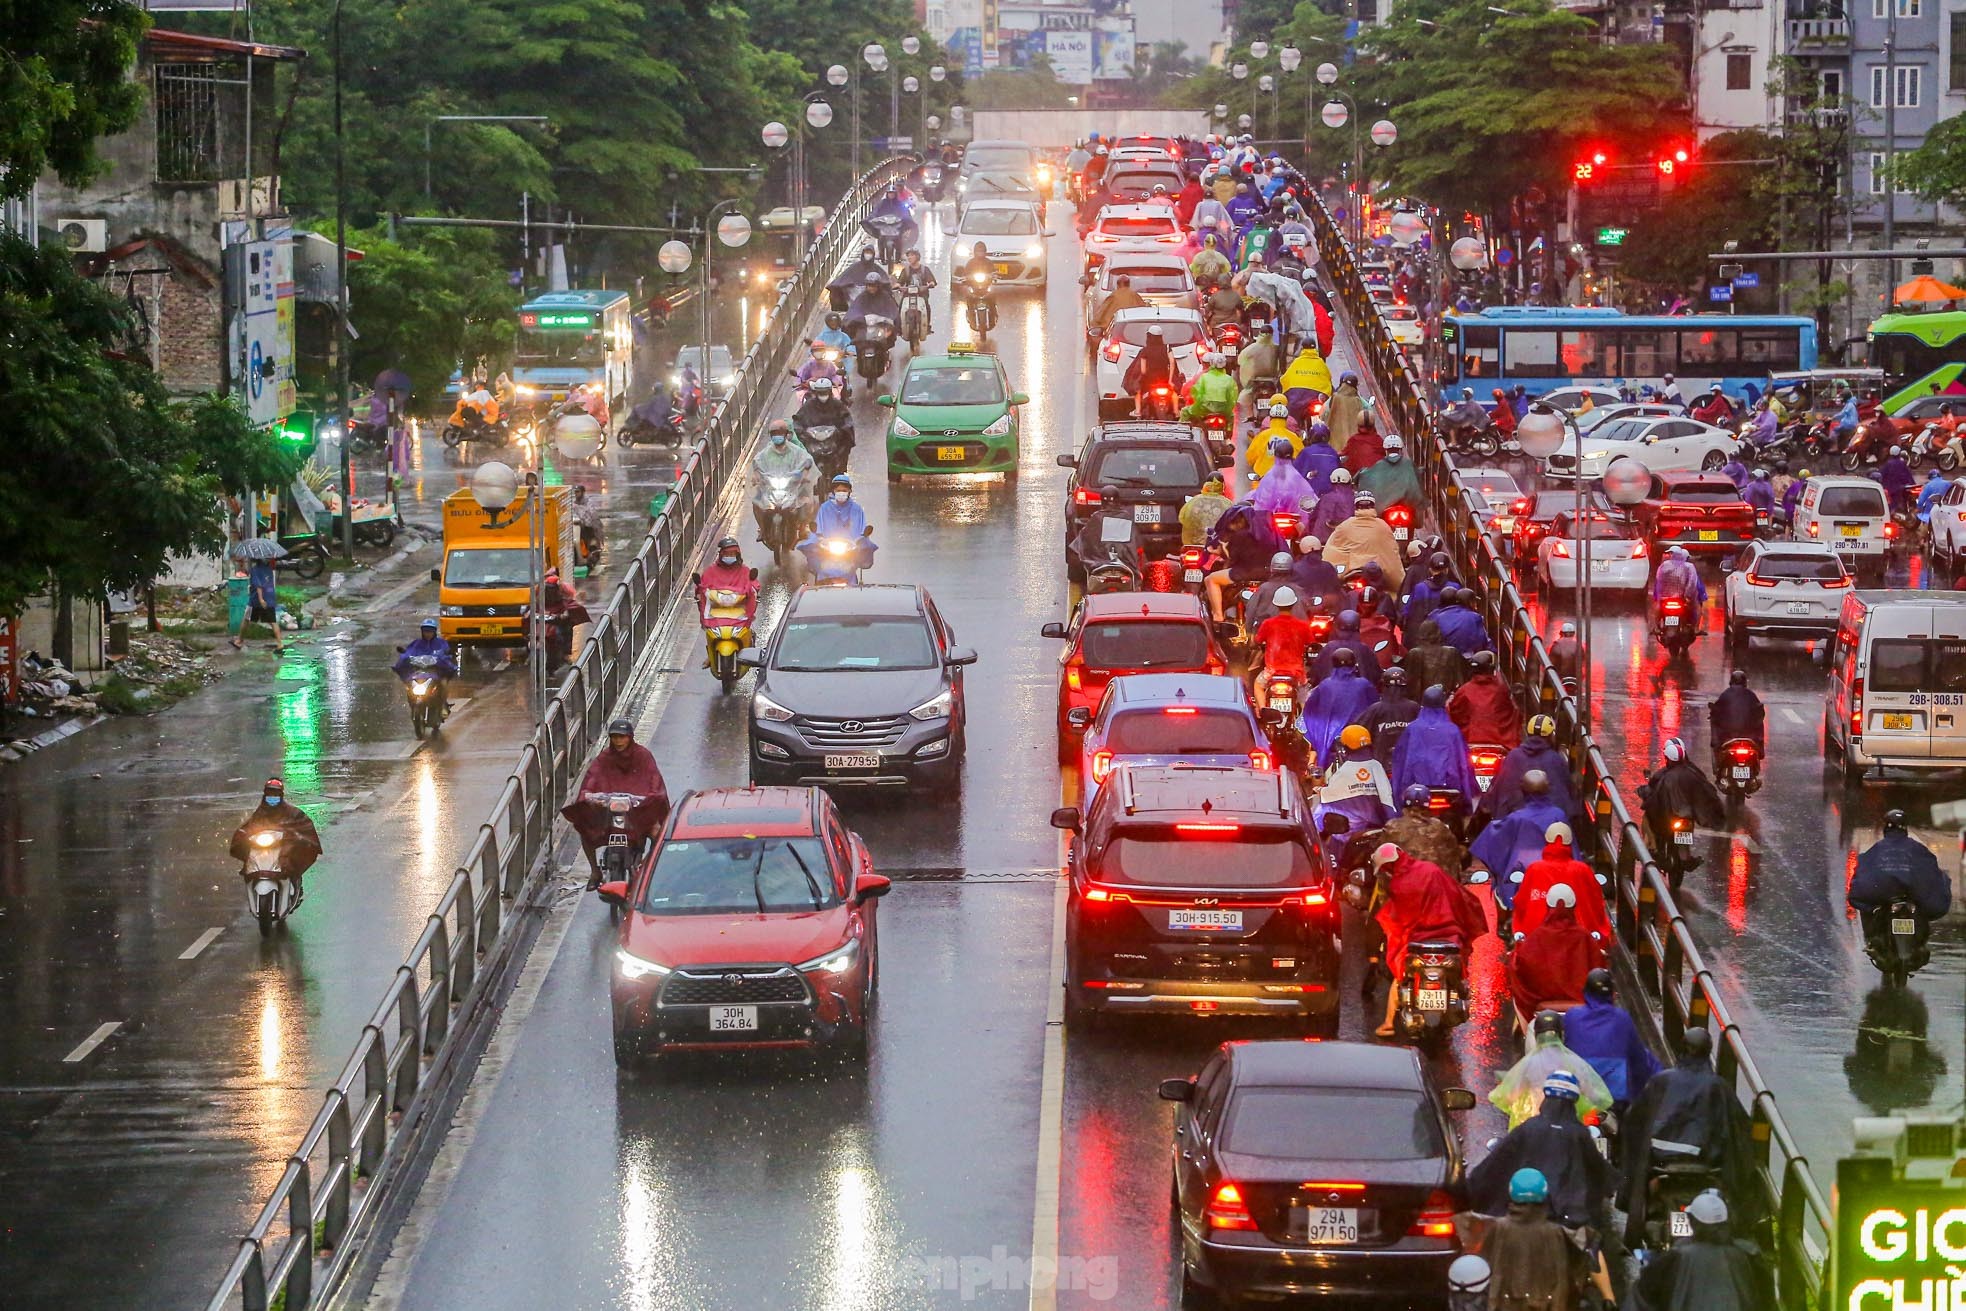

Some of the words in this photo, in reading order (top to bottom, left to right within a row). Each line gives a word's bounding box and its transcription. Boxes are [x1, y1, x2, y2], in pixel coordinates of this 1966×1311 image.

[1576, 165, 1592, 179] 22
[1659, 160, 1673, 174] 49
[1141, 505, 1155, 514] 29A
[1175, 912, 1237, 923] 30H-915.50
[1420, 999, 1445, 1008] 760.55
[723, 1008, 744, 1018] 30H
[715, 1018, 752, 1029] 364.84
[1320, 1209, 1346, 1225] 29A
